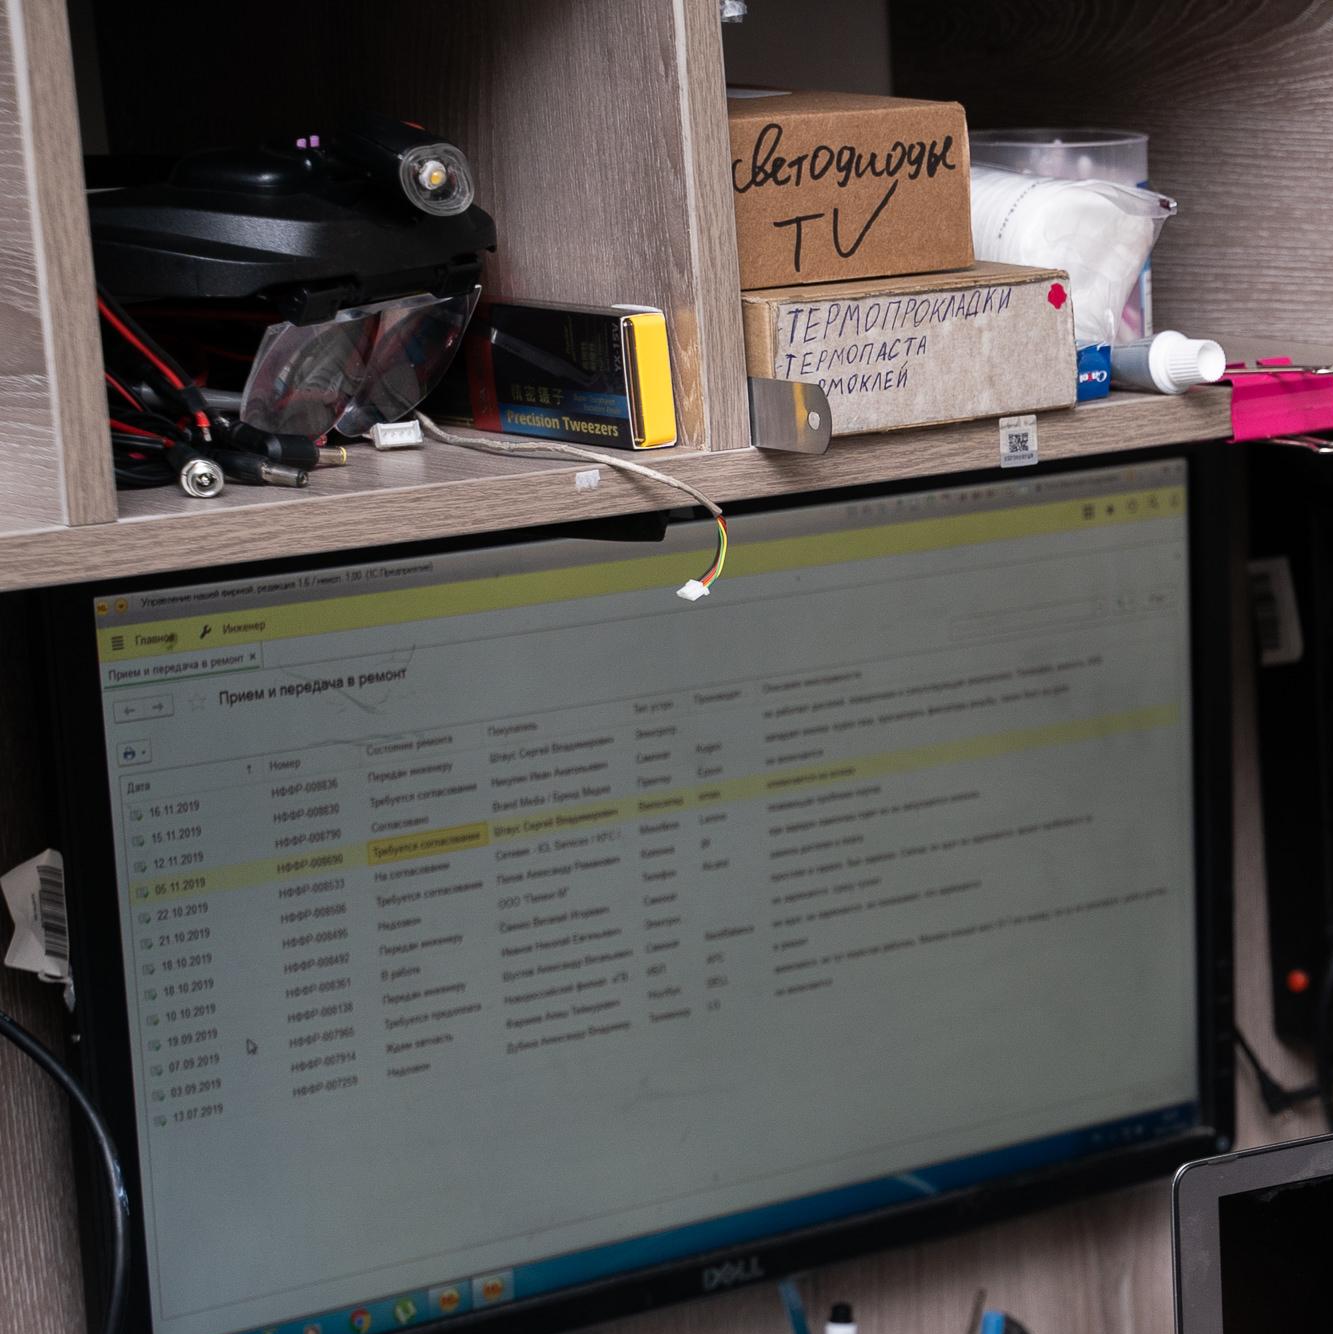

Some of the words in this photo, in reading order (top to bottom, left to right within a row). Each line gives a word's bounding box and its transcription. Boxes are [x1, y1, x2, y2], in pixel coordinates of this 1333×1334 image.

[773, 180, 899, 272] TV
[786, 287, 1012, 344] ТЕРМОПРОКЛАДКИ
[784, 335, 927, 379] ТЕРМОПАСТА
[818, 361, 908, 398] РМОКЛЕЙ
[507, 409, 560, 430] Precision
[562, 416, 618, 437] Tweezers
[222, 619, 266, 635] Инженер
[108, 666, 141, 683] Прием
[144, 666, 150, 676] и
[152, 659, 200, 676] передача
[202, 660, 208, 668] в
[211, 654, 244, 668] ремонт
[219, 686, 265, 706] Прием
[268, 687, 276, 698] и
[280, 676, 344, 697] передача
[347, 677, 355, 688] в
[358, 666, 407, 687] ремонт
[270, 758, 301, 773] Номер
[127, 781, 151, 796] Дата
[703, 1256, 765, 1291] DELL
